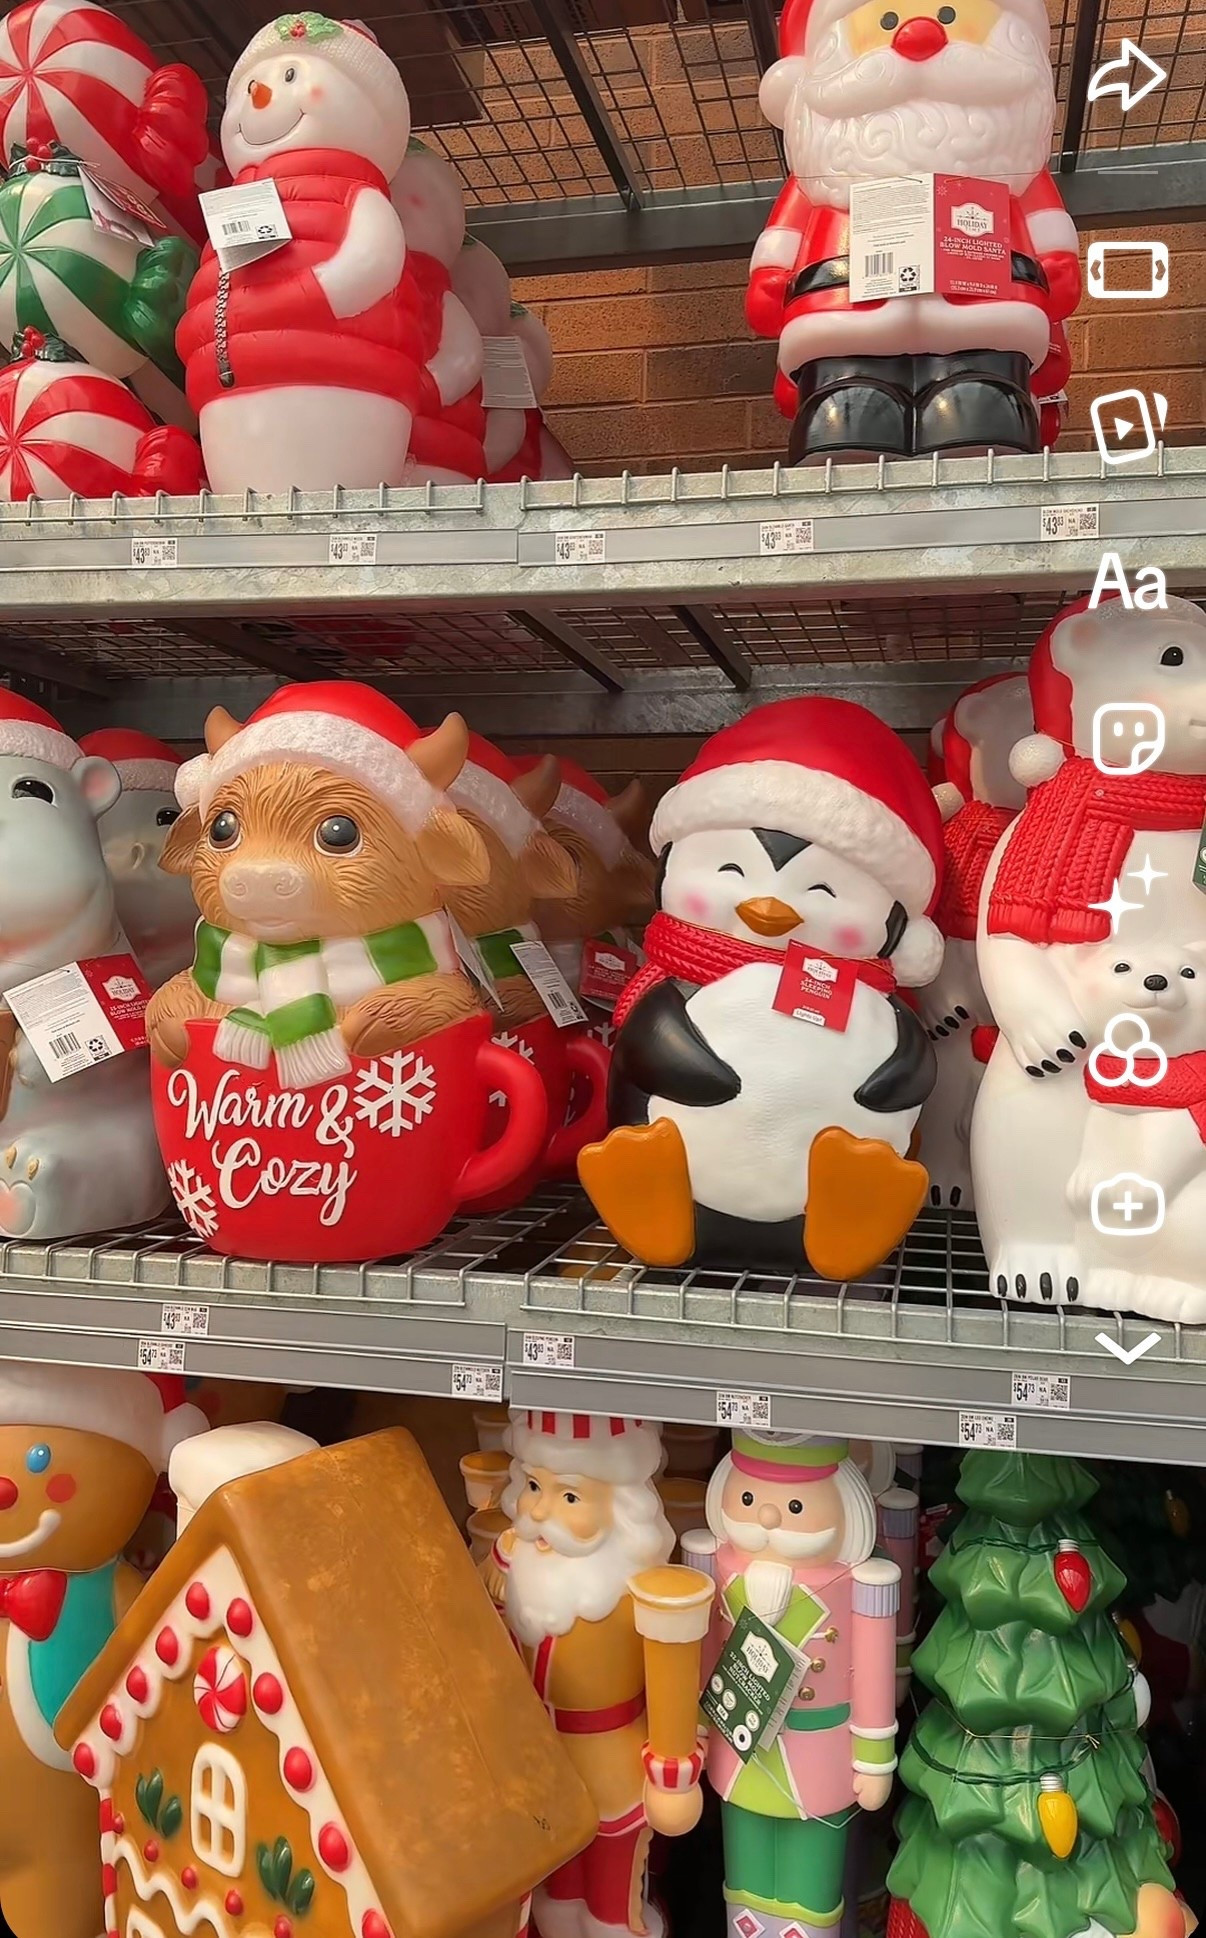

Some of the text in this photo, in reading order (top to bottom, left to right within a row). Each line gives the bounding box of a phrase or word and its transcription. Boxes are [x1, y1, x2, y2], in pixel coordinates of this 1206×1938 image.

[957, 219, 987, 229] HOLIDAY
[939, 241, 961, 249] BLOW
[962, 244, 983, 252] MOLD
[983, 246, 1007, 255] SANTA
[943, 236, 1003, 249] 24-INCH LIGHTED
[800, 986, 831, 999] PENGUIN
[167, 1069, 355, 1159] Warm &
[211, 1137, 358, 1226] Cozy
[746, 1646, 769, 1674] HOLIDAY
[729, 1666, 762, 1706] NUTCRACKER
[732, 1663, 749, 1681] BLOW
[746, 1680, 763, 1699] MOLD
[748, 1673, 771, 1702] LIGHTED
